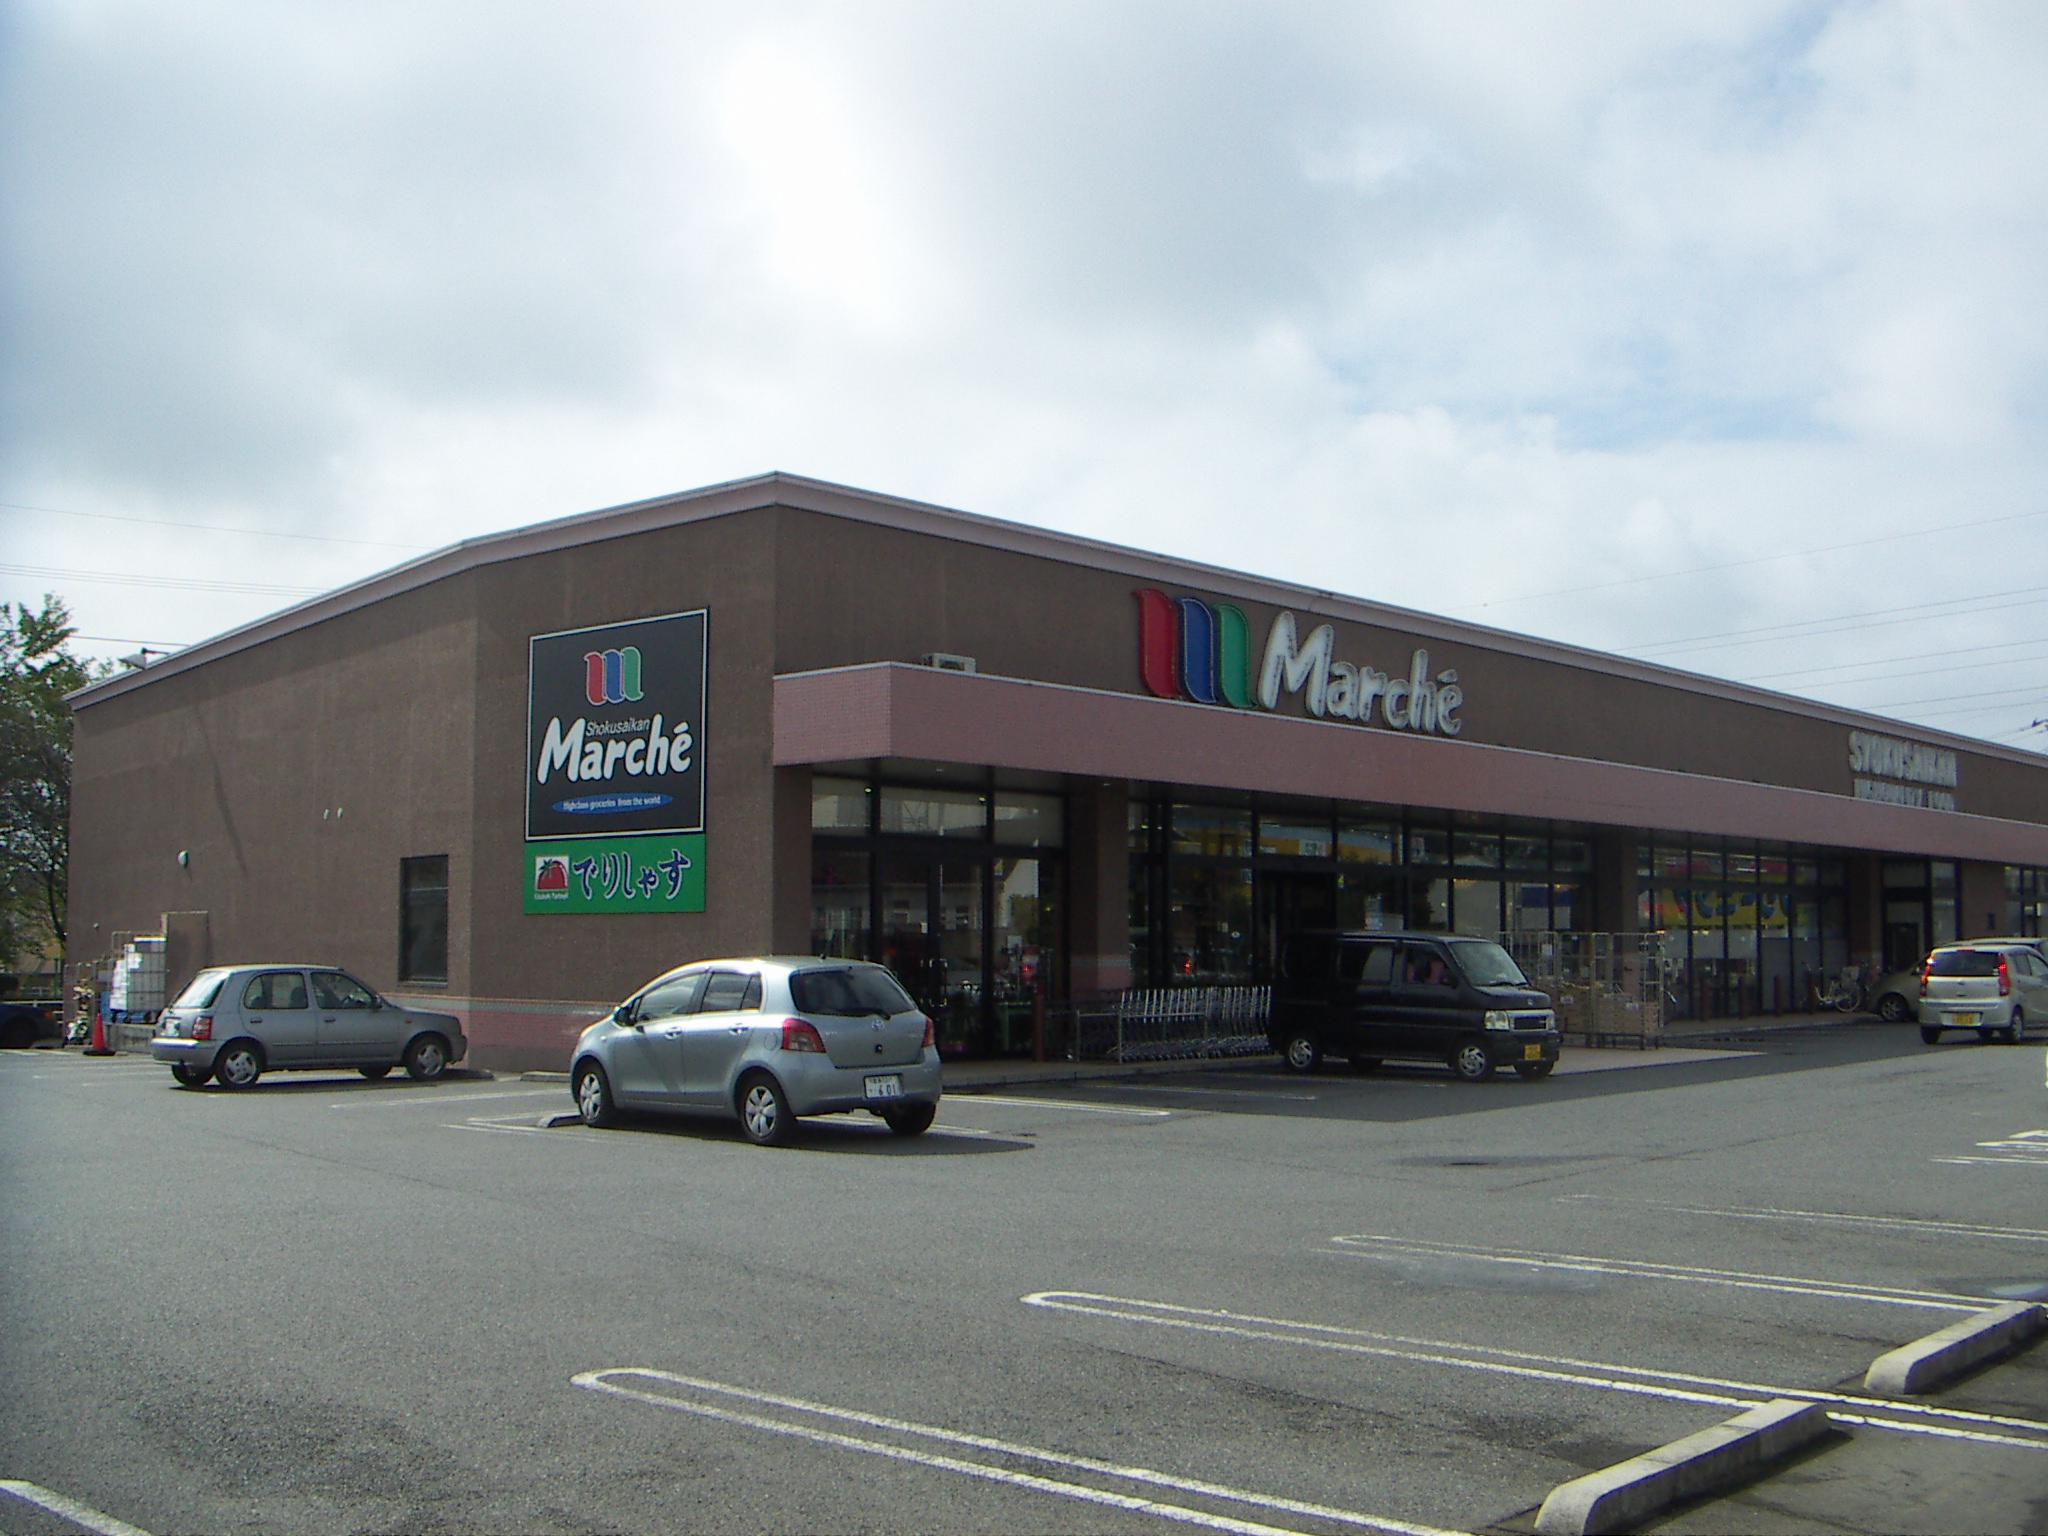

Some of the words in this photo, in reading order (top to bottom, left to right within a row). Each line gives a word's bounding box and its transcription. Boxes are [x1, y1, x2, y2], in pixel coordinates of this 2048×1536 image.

[537, 713, 693, 784] Marché
[586, 717, 650, 736] Shokusaikan
[572, 848, 692, 901] でりしゃす
